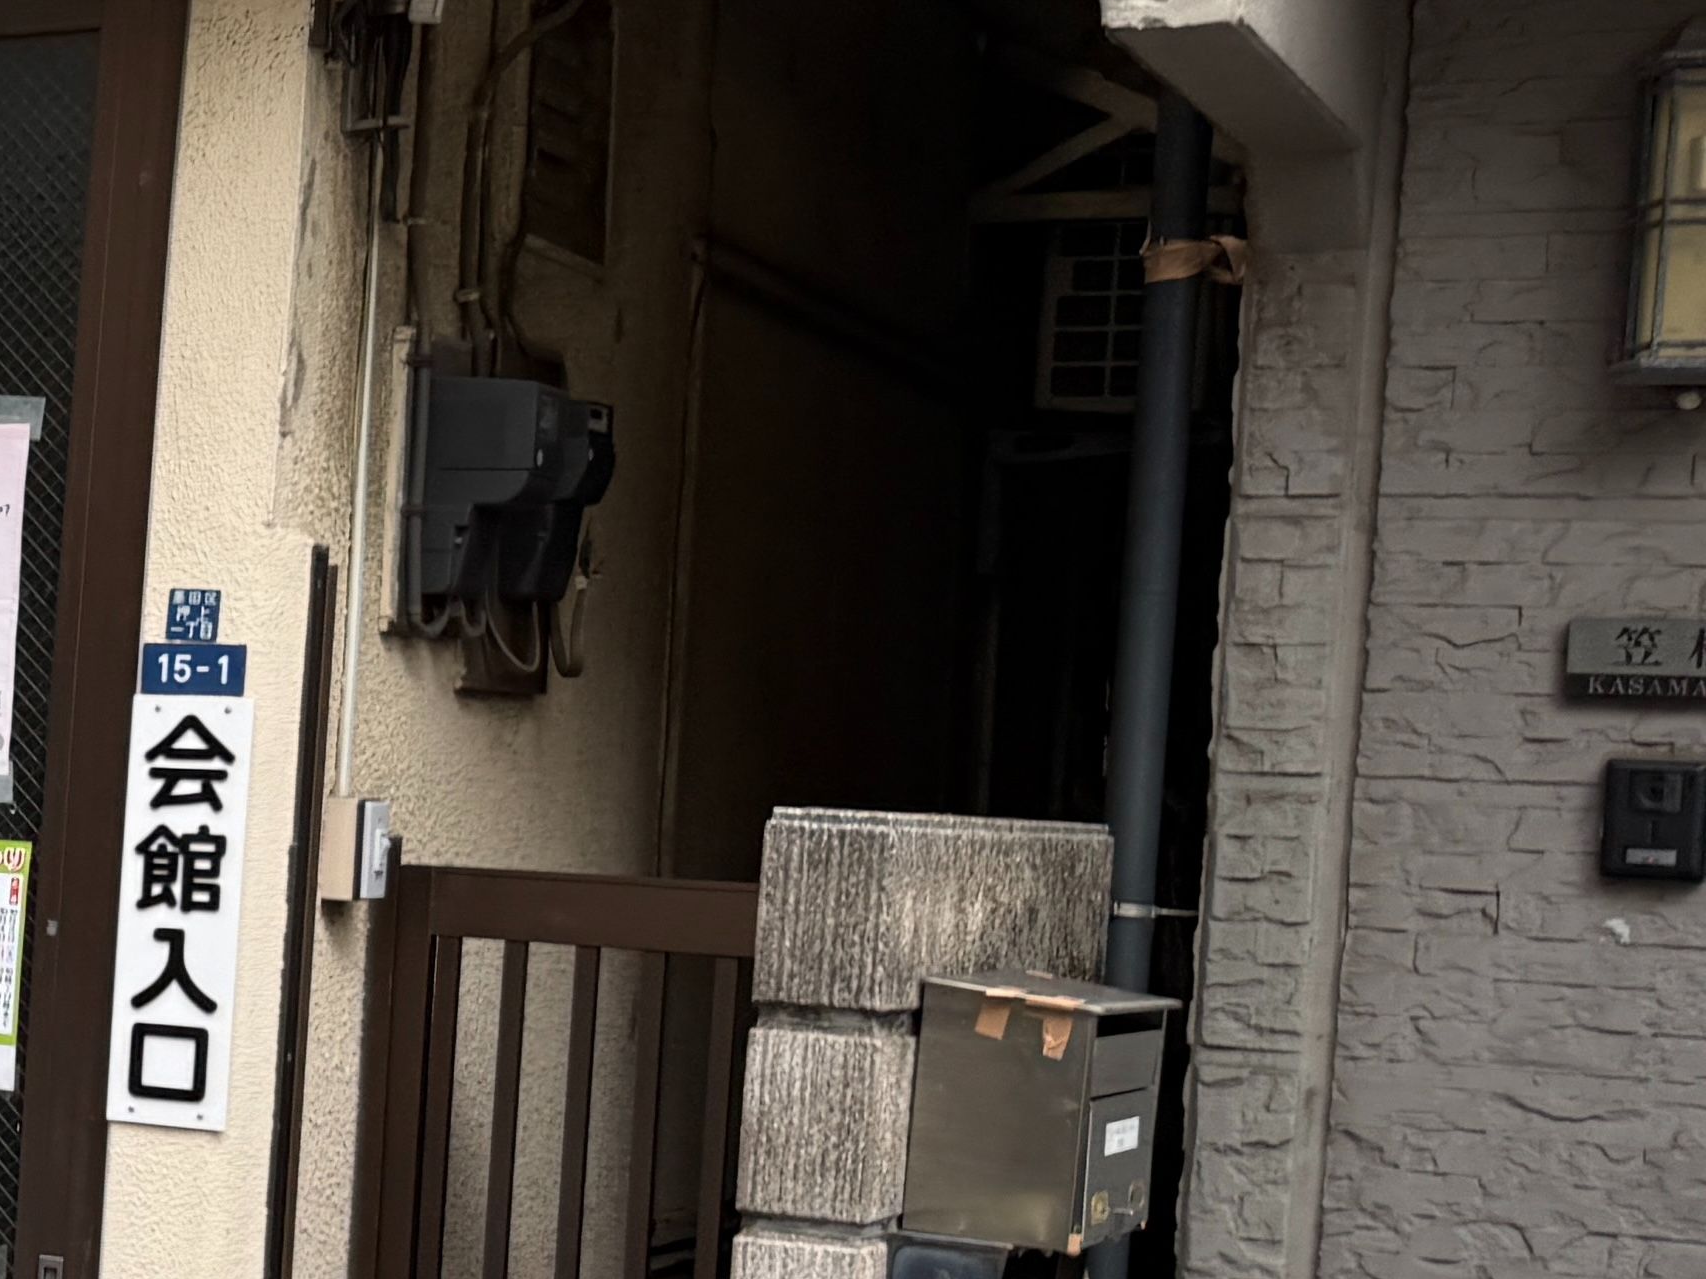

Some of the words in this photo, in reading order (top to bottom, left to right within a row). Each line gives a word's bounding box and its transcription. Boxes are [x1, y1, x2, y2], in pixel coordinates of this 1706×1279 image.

[157, 652, 230, 685] 15-1
[1611, 625, 1706, 670] 笠
[128, 714, 236, 1103] 会館入口
